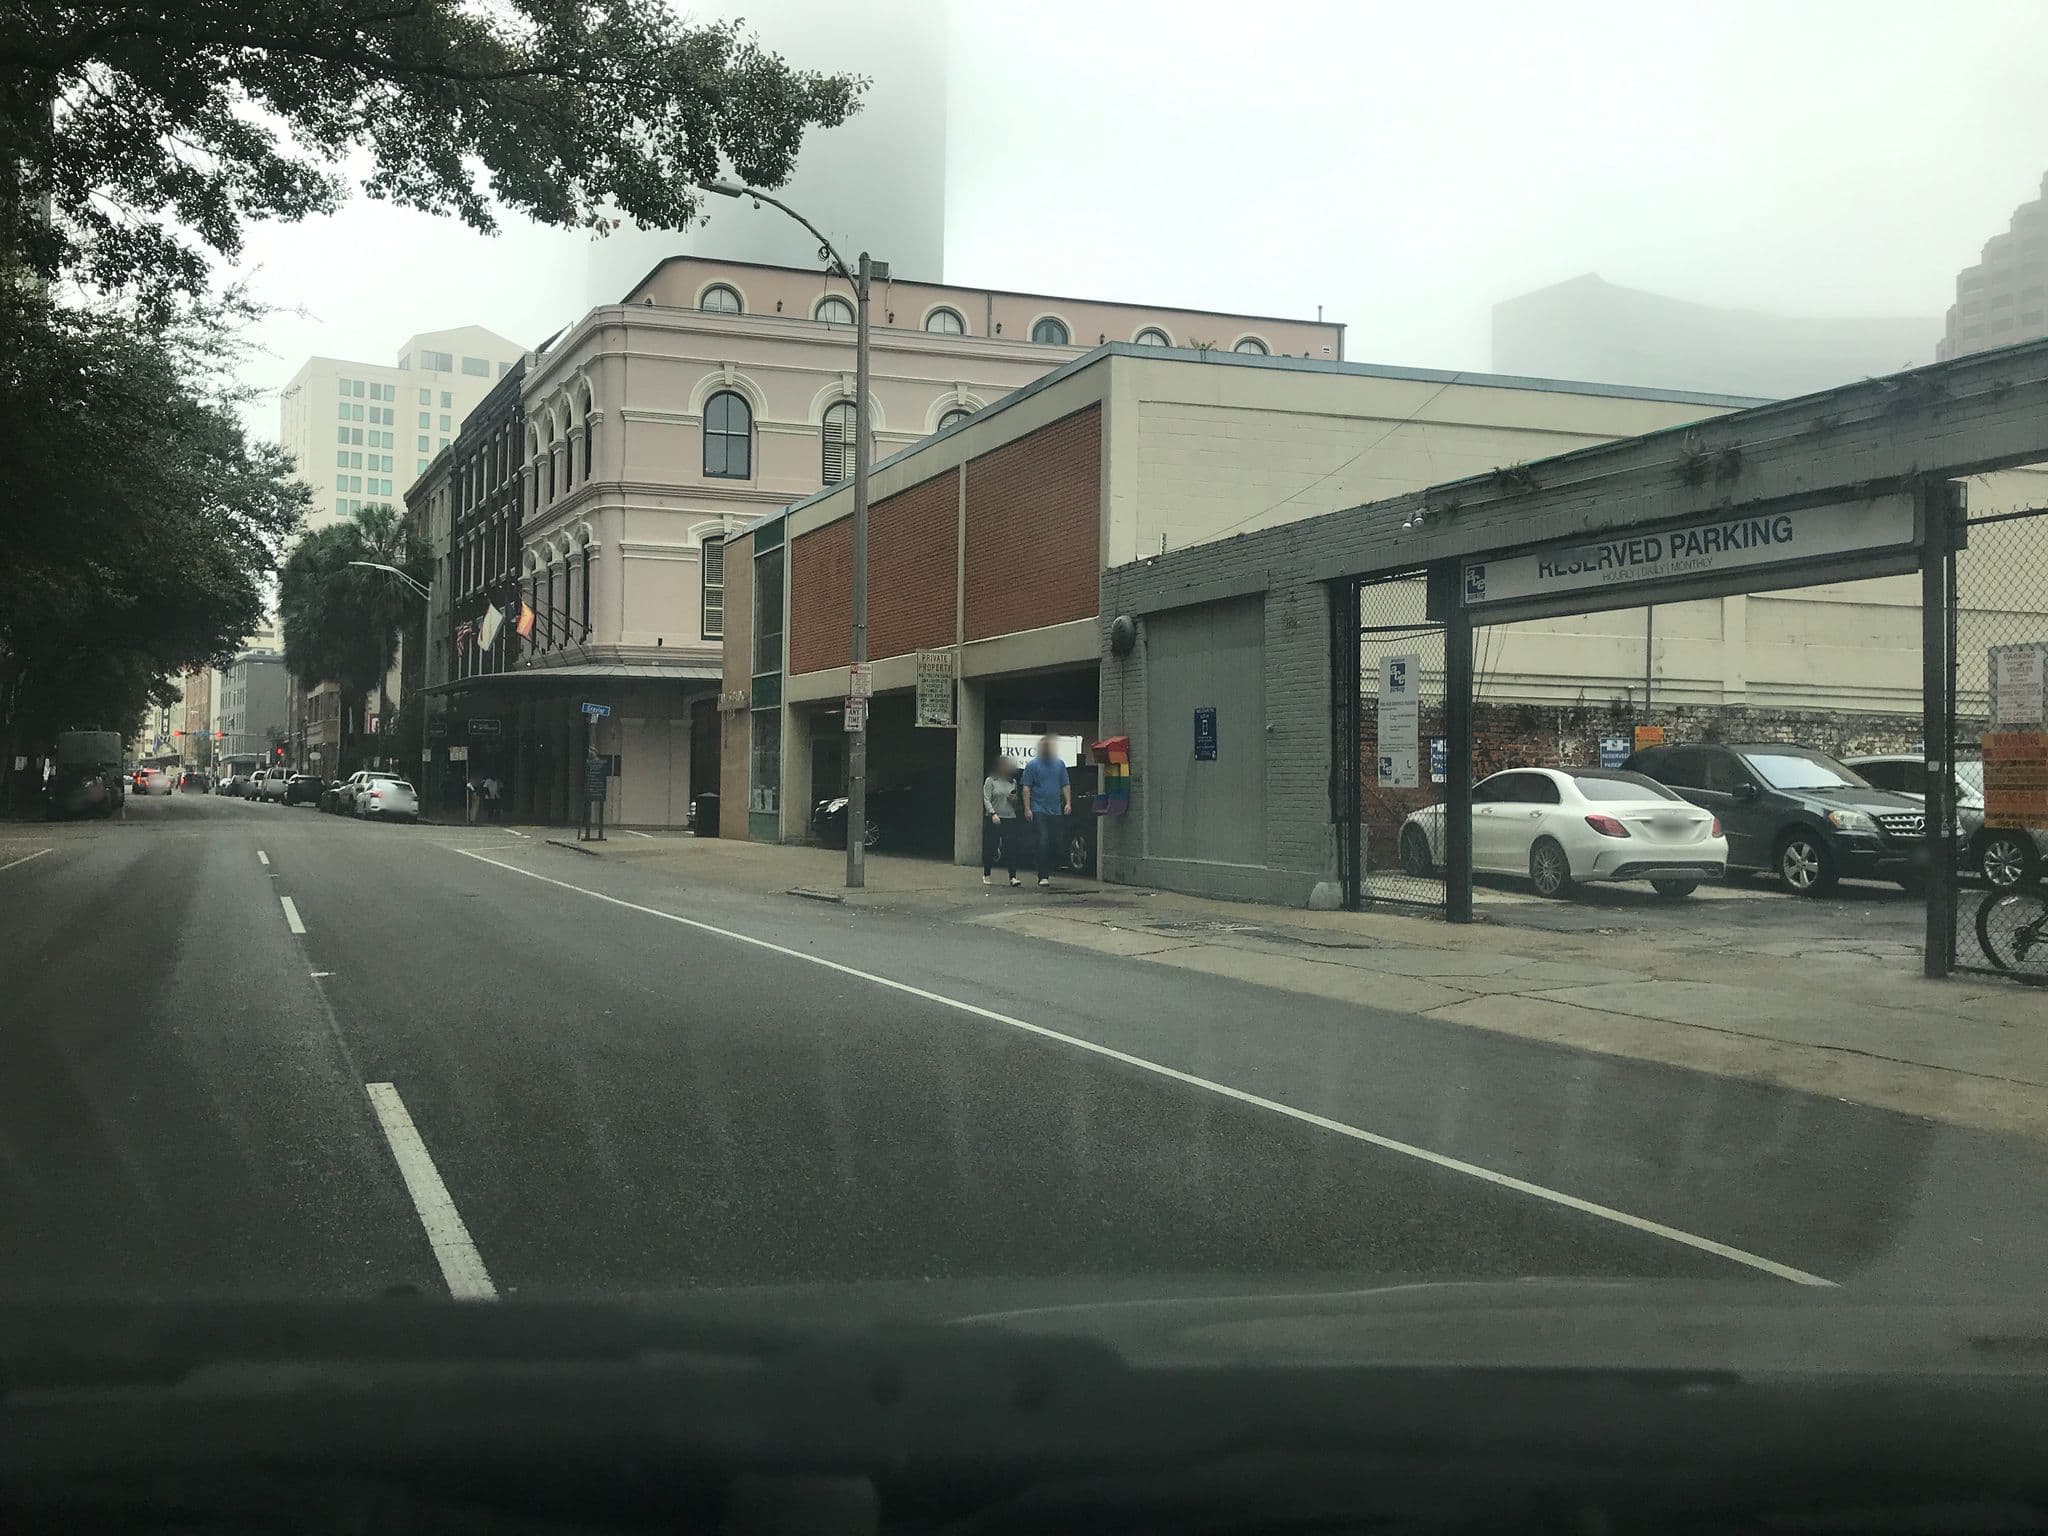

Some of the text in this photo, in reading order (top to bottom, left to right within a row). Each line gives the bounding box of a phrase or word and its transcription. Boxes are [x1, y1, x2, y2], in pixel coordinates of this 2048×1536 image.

[1670, 515, 1793, 559] PARKING
[1641, 563, 1665, 577] DAILY
[1671, 556, 1713, 573] MONTHLY
[922, 654, 948, 664] PRIVATE
[918, 663, 951, 672] PROPERTY
